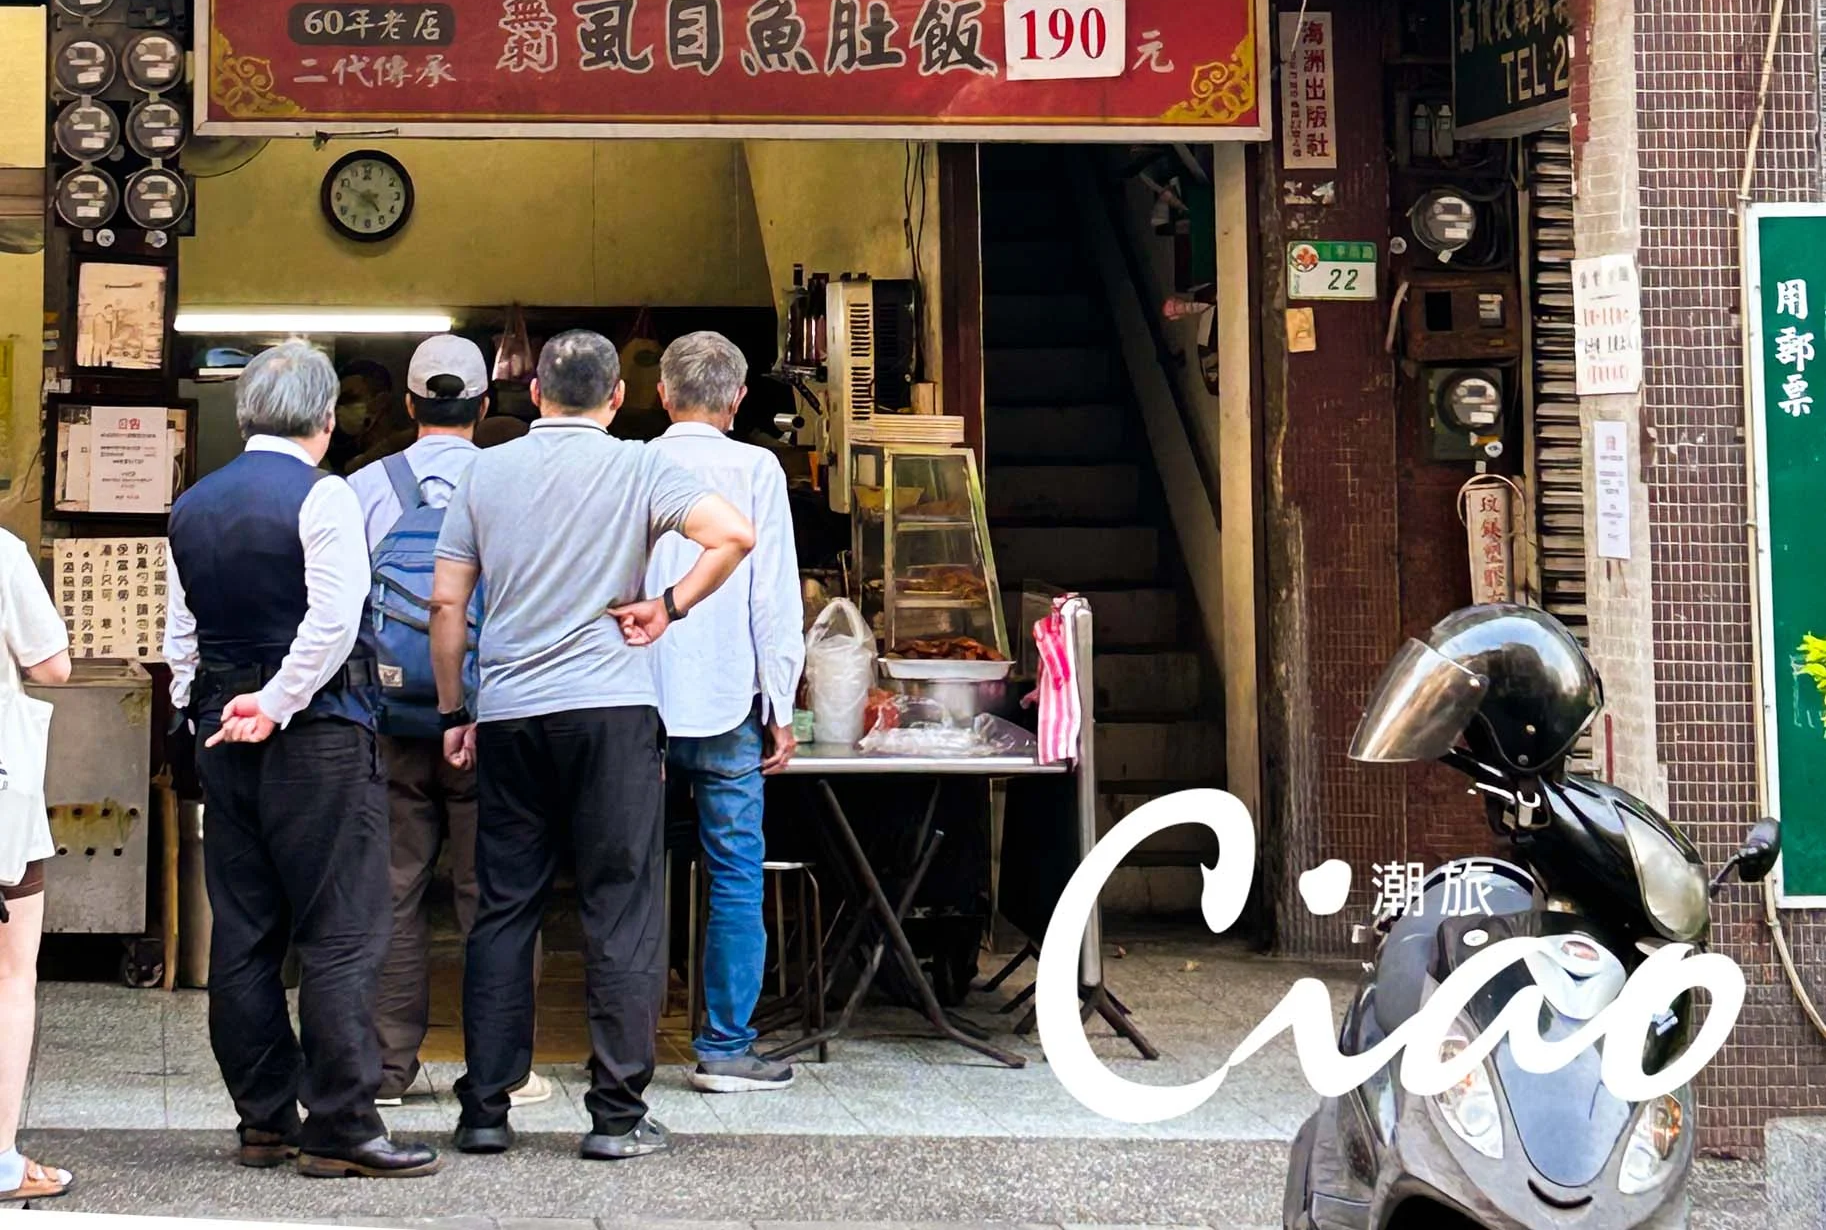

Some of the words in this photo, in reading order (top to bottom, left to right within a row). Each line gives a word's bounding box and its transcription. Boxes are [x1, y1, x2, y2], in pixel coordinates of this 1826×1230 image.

[304, 7, 442, 41] 60年老店
[1019, 6, 1108, 61] 190
[1133, 30, 1175, 73] 元
[293, 53, 456, 89] 二代傳承
[1327, 268, 1359, 291] 22
[1774, 277, 1816, 418] 用郵票
